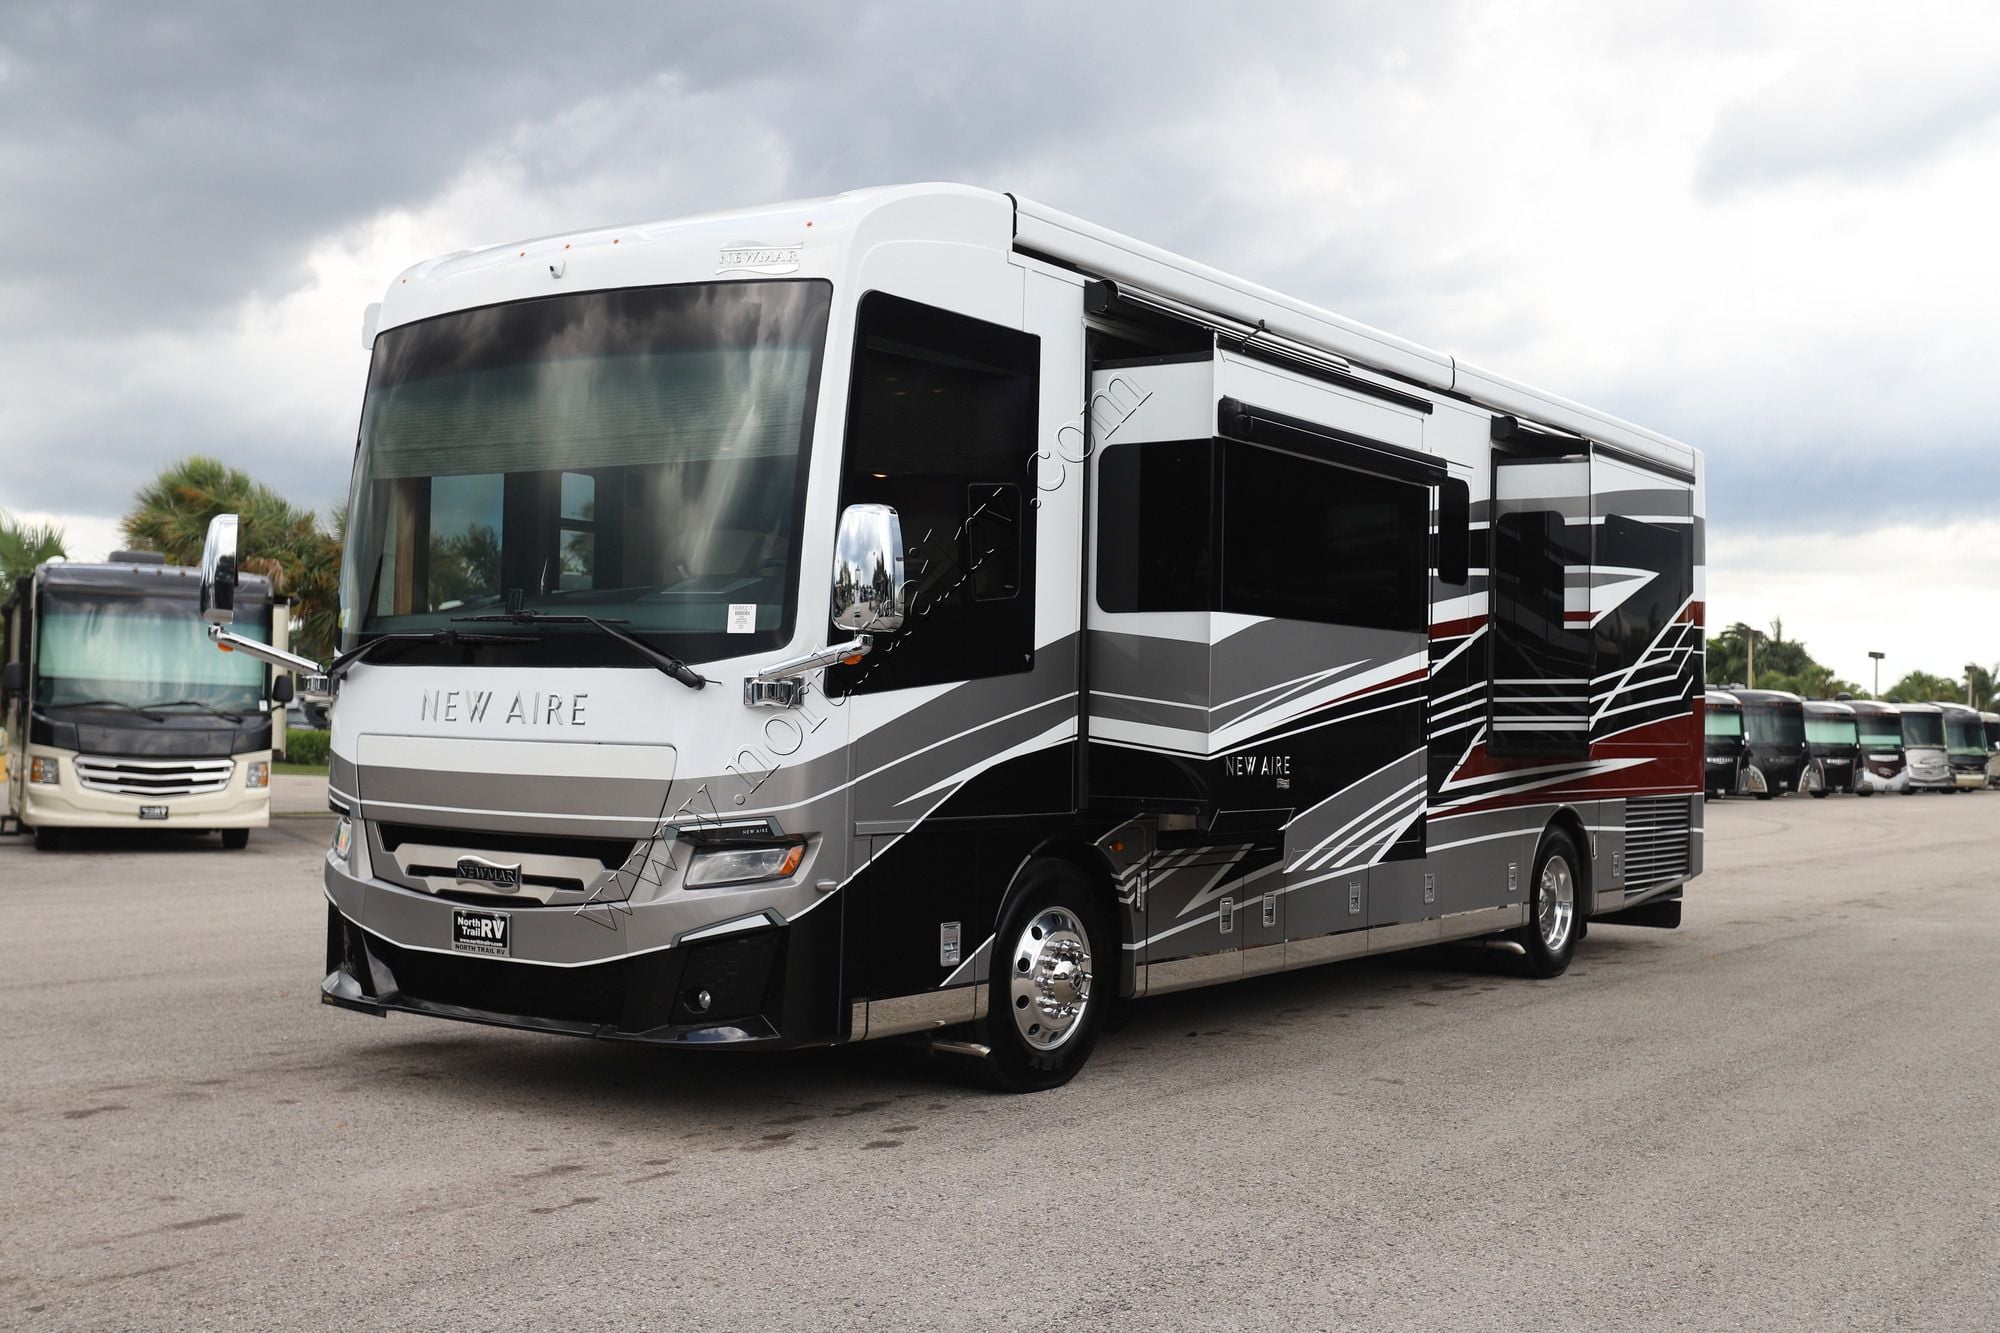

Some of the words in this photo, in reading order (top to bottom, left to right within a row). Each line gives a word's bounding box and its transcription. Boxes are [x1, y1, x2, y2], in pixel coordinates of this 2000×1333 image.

[719, 250, 799, 265] NEWMAR
[421, 688, 493, 723] NEW
[505, 690, 588, 726] AIRE
[1225, 756, 1256, 776] NEW
[1260, 756, 1290, 775] AIRE
[458, 865, 515, 882] NEWMAR
[457, 916, 480, 927] North
[481, 918, 505, 939] RV
[462, 926, 480, 937] Trail
[455, 943, 475, 951] NORTH
[477, 946, 495, 954] TRAIL
